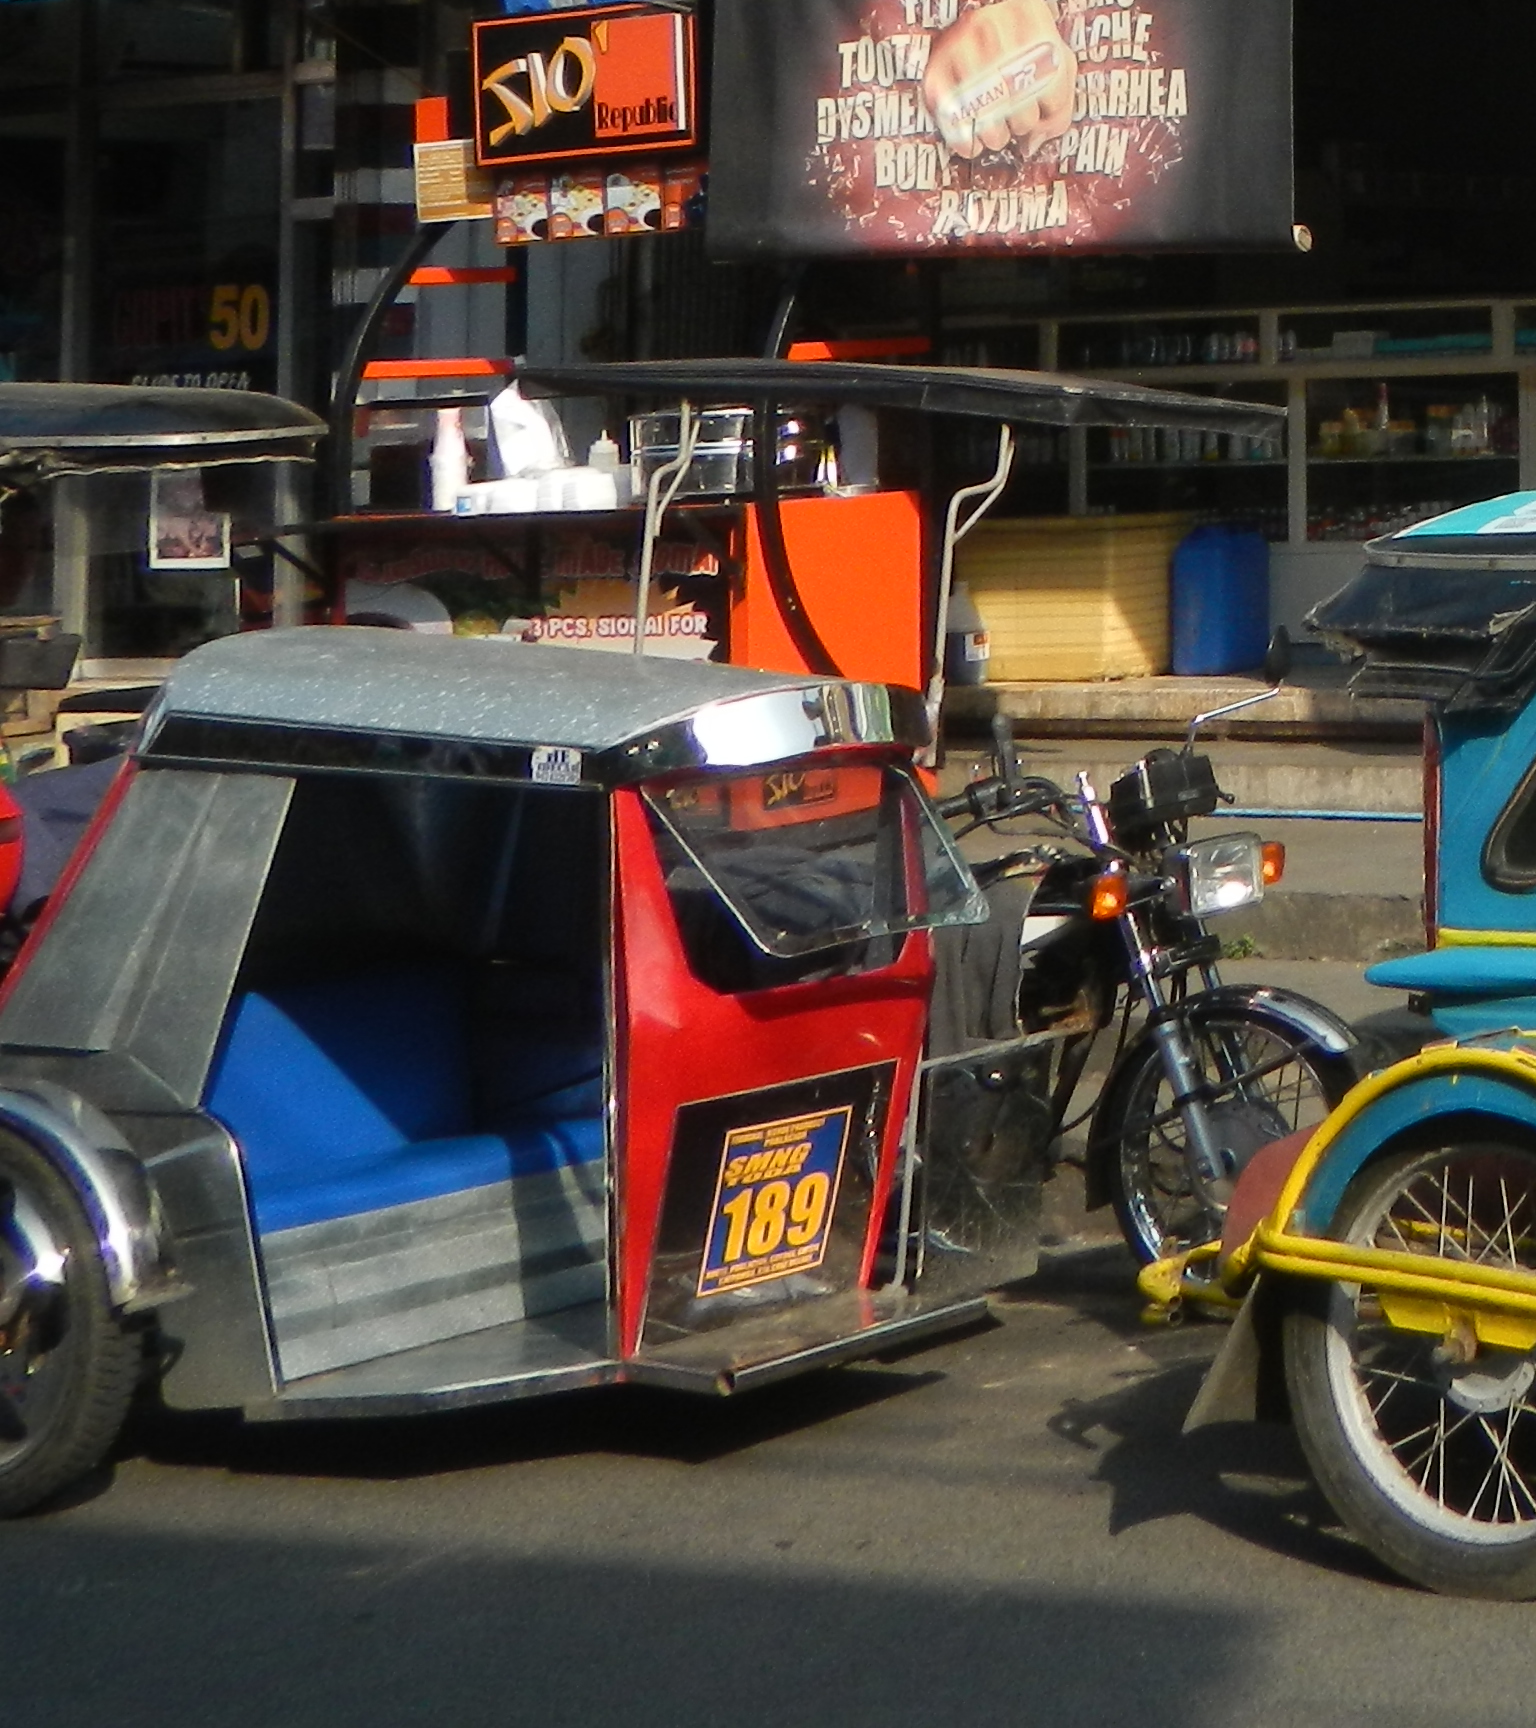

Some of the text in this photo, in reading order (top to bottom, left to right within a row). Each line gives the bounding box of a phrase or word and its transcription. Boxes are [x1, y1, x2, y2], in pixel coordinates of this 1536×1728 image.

[837, 9, 1154, 89] TOOTH ACHE
[874, 122, 1131, 191] BODY PAIN
[210, 283, 270, 351] 50
[531, 617, 543, 637] 3
[669, 612, 709, 636] FOR
[722, 1171, 831, 1264] 189
